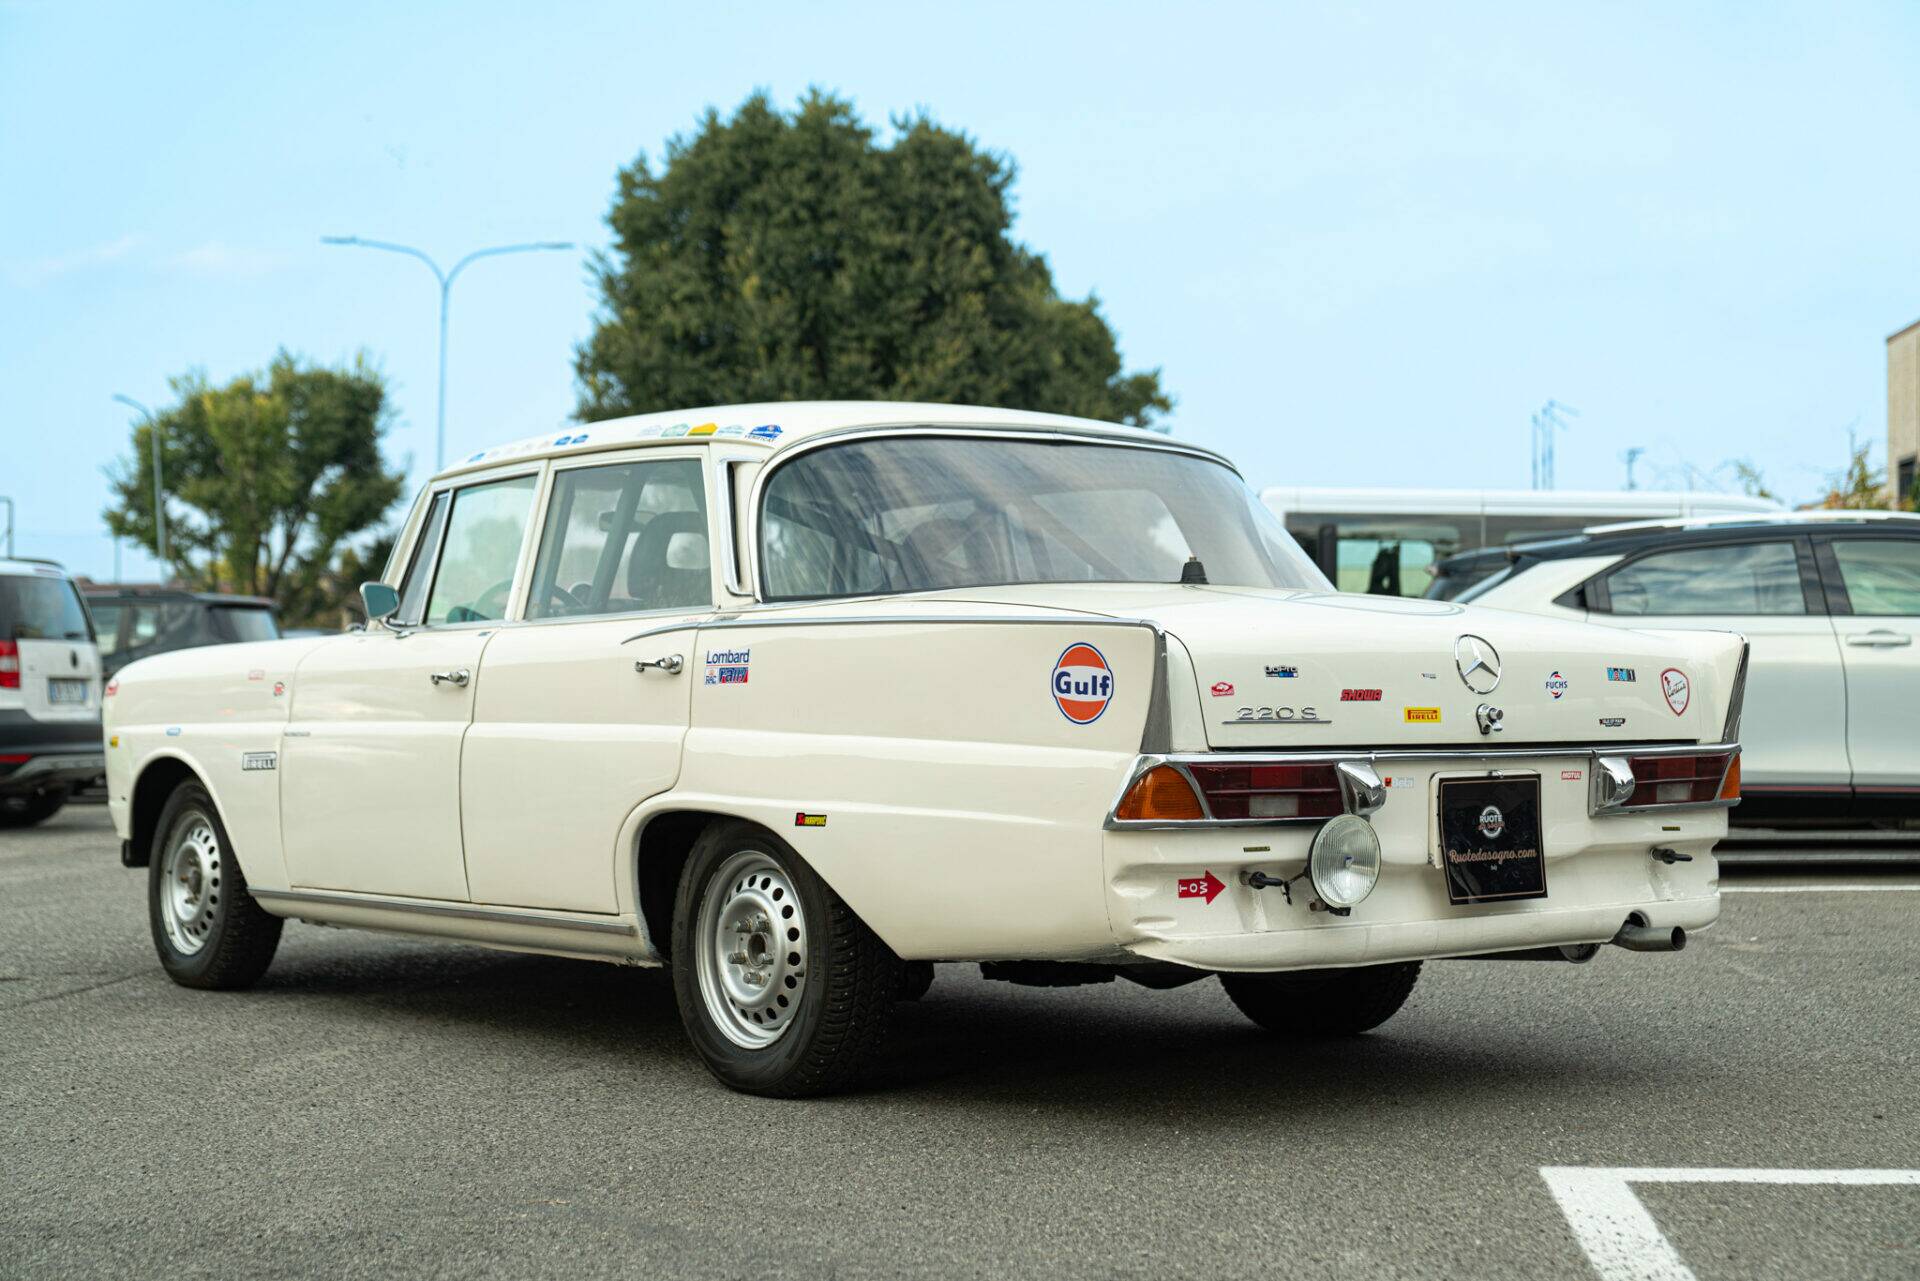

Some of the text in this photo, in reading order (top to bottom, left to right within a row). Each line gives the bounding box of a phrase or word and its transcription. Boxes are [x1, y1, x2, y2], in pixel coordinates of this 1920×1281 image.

[706, 648, 751, 664] Lombard
[1265, 665, 1298, 674] GoPro
[1055, 671, 1110, 696] Gulf
[1545, 680, 1568, 689] FUCHS
[1340, 689, 1382, 701] SHOWA
[1236, 706, 1318, 720] 220 S
[1407, 709, 1438, 721] PIRELLI
[1562, 771, 1581, 779] MOTUL
[1479, 815, 1502, 823] RUOTE
[1449, 848, 1537, 865] Ruotedasogno.com
[1179, 881, 1208, 894] TOW
